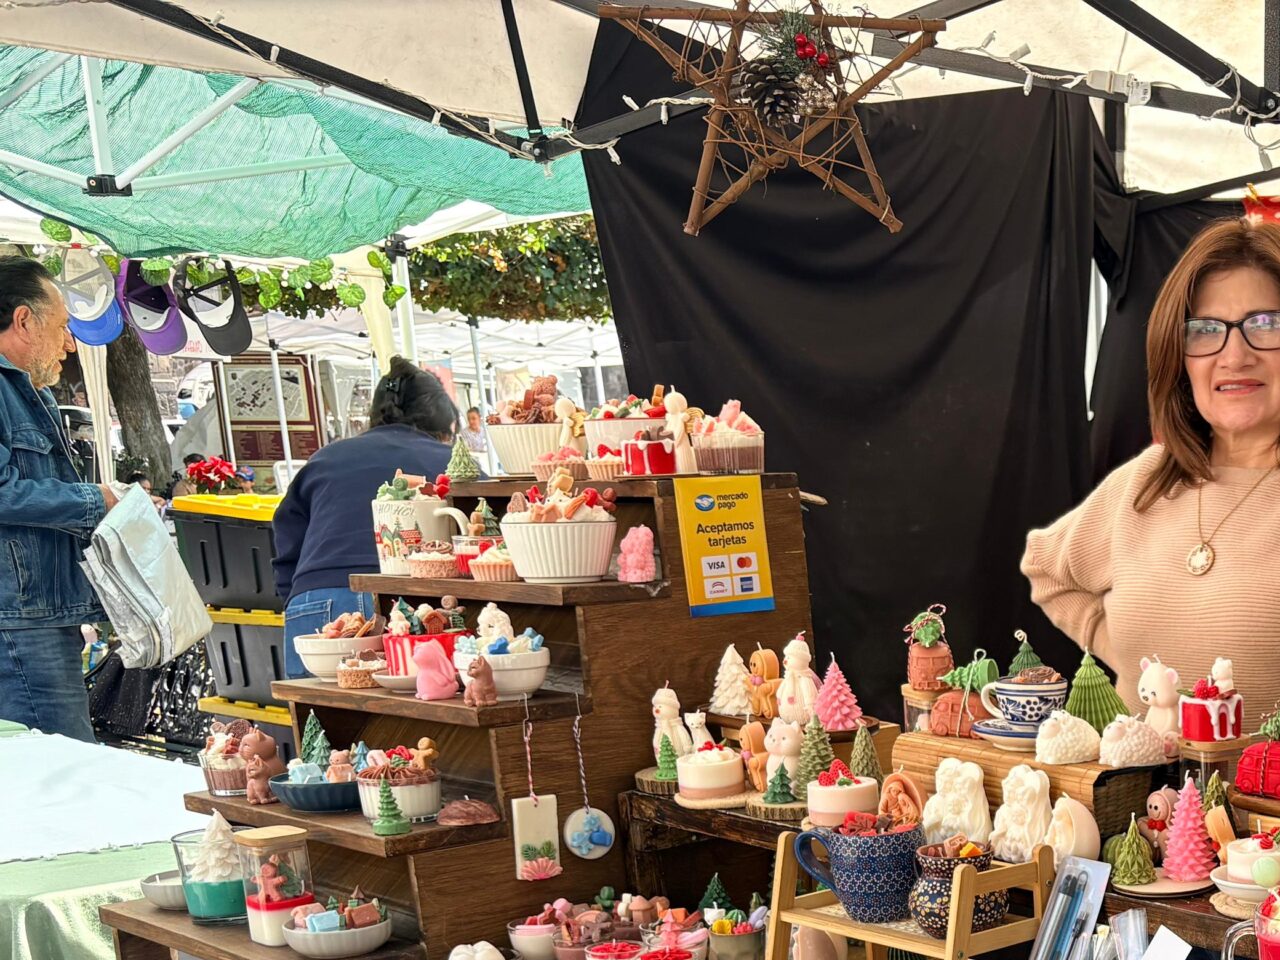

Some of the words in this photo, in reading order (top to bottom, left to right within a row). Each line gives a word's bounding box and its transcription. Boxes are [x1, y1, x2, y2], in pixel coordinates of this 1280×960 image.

[716, 491, 749, 501] mercado
[717, 501, 737, 510] pago
[696, 521, 755, 535] Aceptamos
[707, 535, 747, 549] tarjetas
[707, 560, 726, 570] VISA
